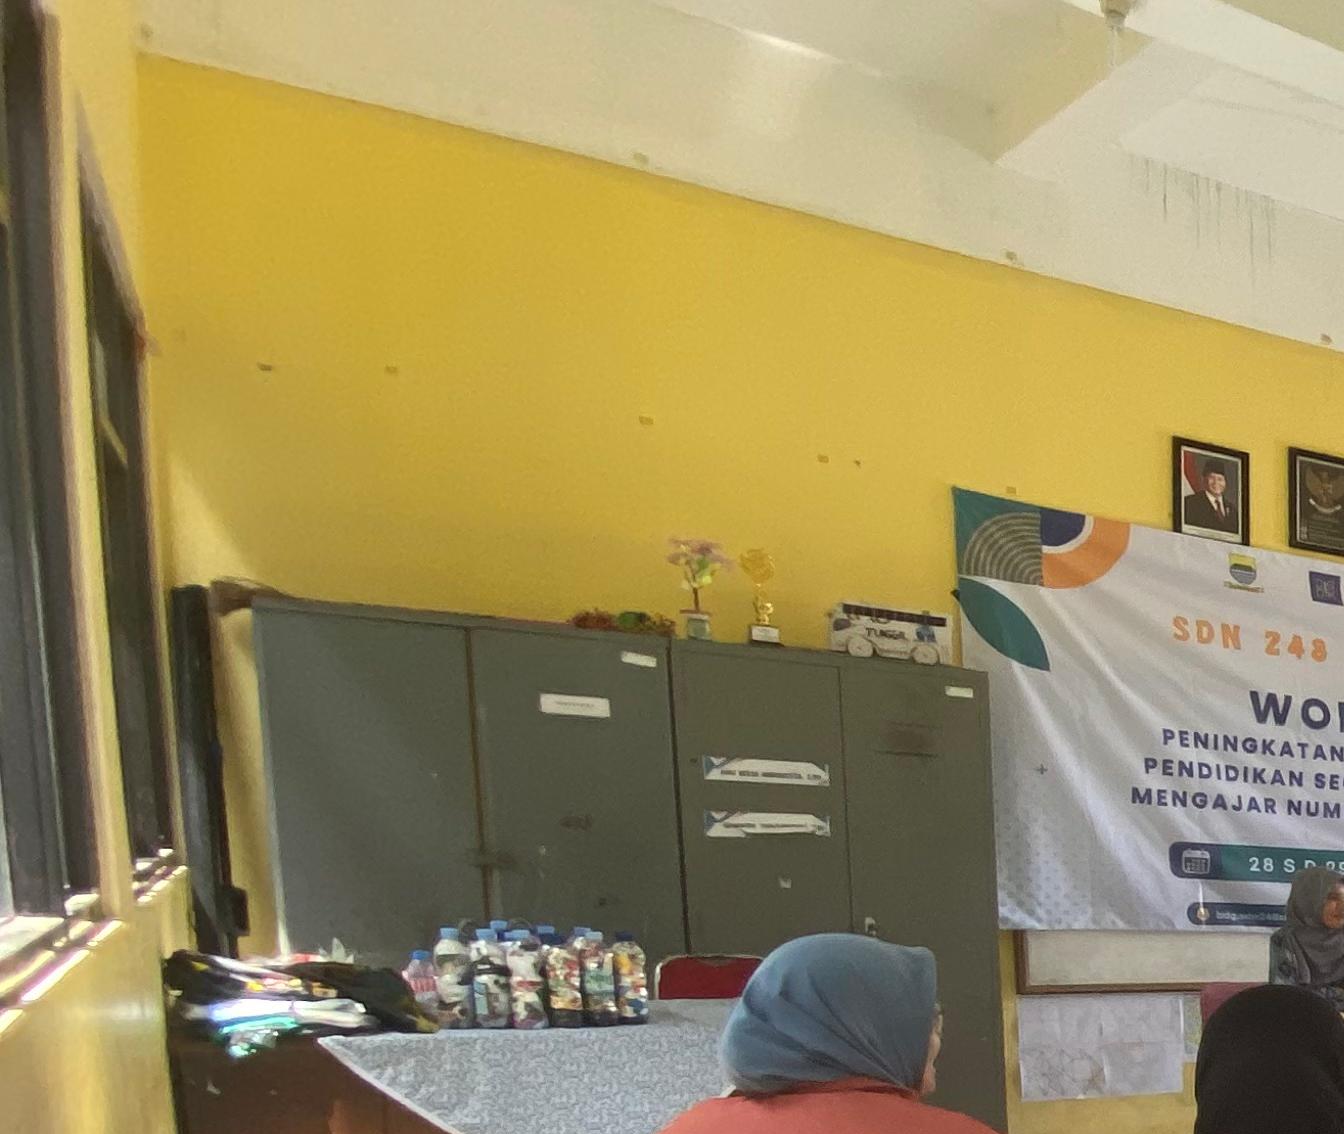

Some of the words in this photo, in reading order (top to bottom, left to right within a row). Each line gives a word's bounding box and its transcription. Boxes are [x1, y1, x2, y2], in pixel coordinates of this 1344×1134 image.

[1172, 615, 1242, 650] SDN
[1264, 629, 1328, 663] 248
[1162, 728, 1344, 763] PENINGKATAN
[1144, 757, 1304, 788] PENDIDIKAN
[1131, 786, 1277, 815] MENGAJAR
[1248, 856, 1274, 873] 28
